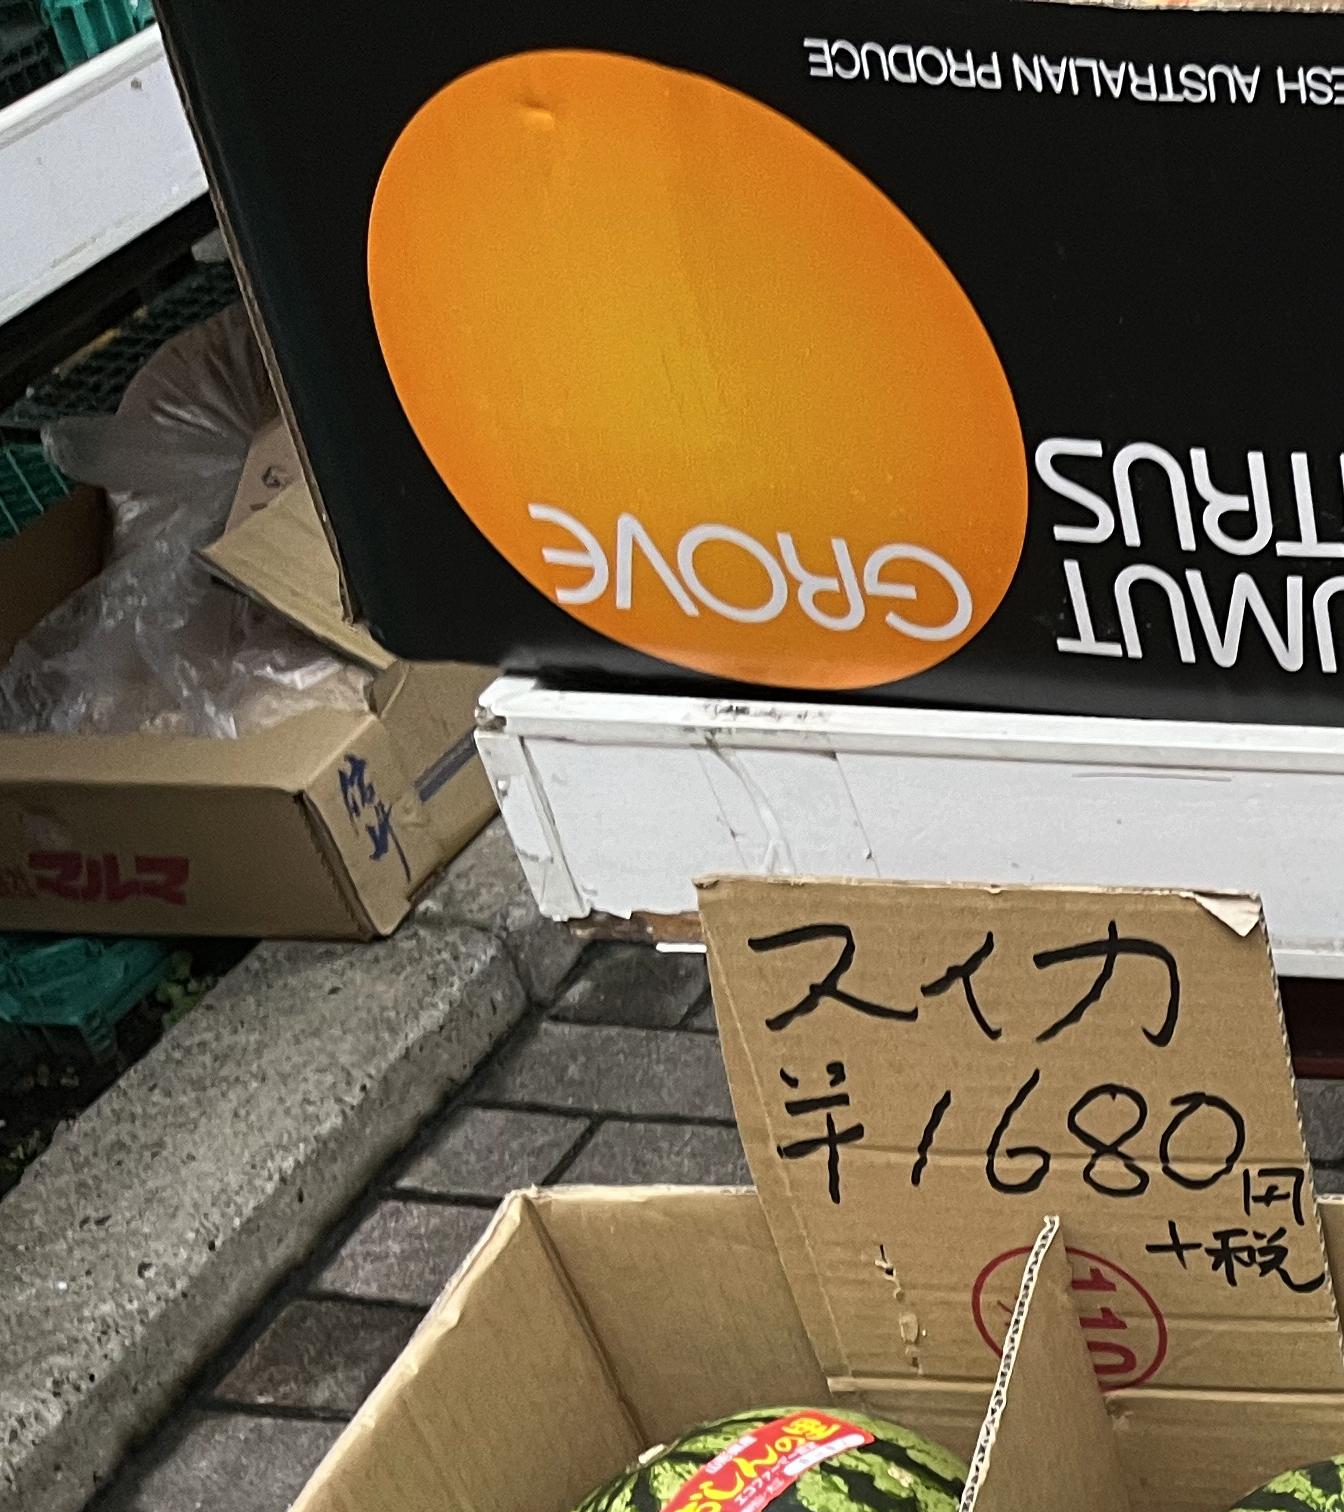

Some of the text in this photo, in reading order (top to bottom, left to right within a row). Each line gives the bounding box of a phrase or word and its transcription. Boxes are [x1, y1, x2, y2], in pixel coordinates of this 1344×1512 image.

[804, 37, 1002, 89] PRODUCE
[1013, 51, 1260, 104] AUSTRALIAN
[529, 502, 974, 641] GROVE
[748, 920, 1180, 1047] スイカ
